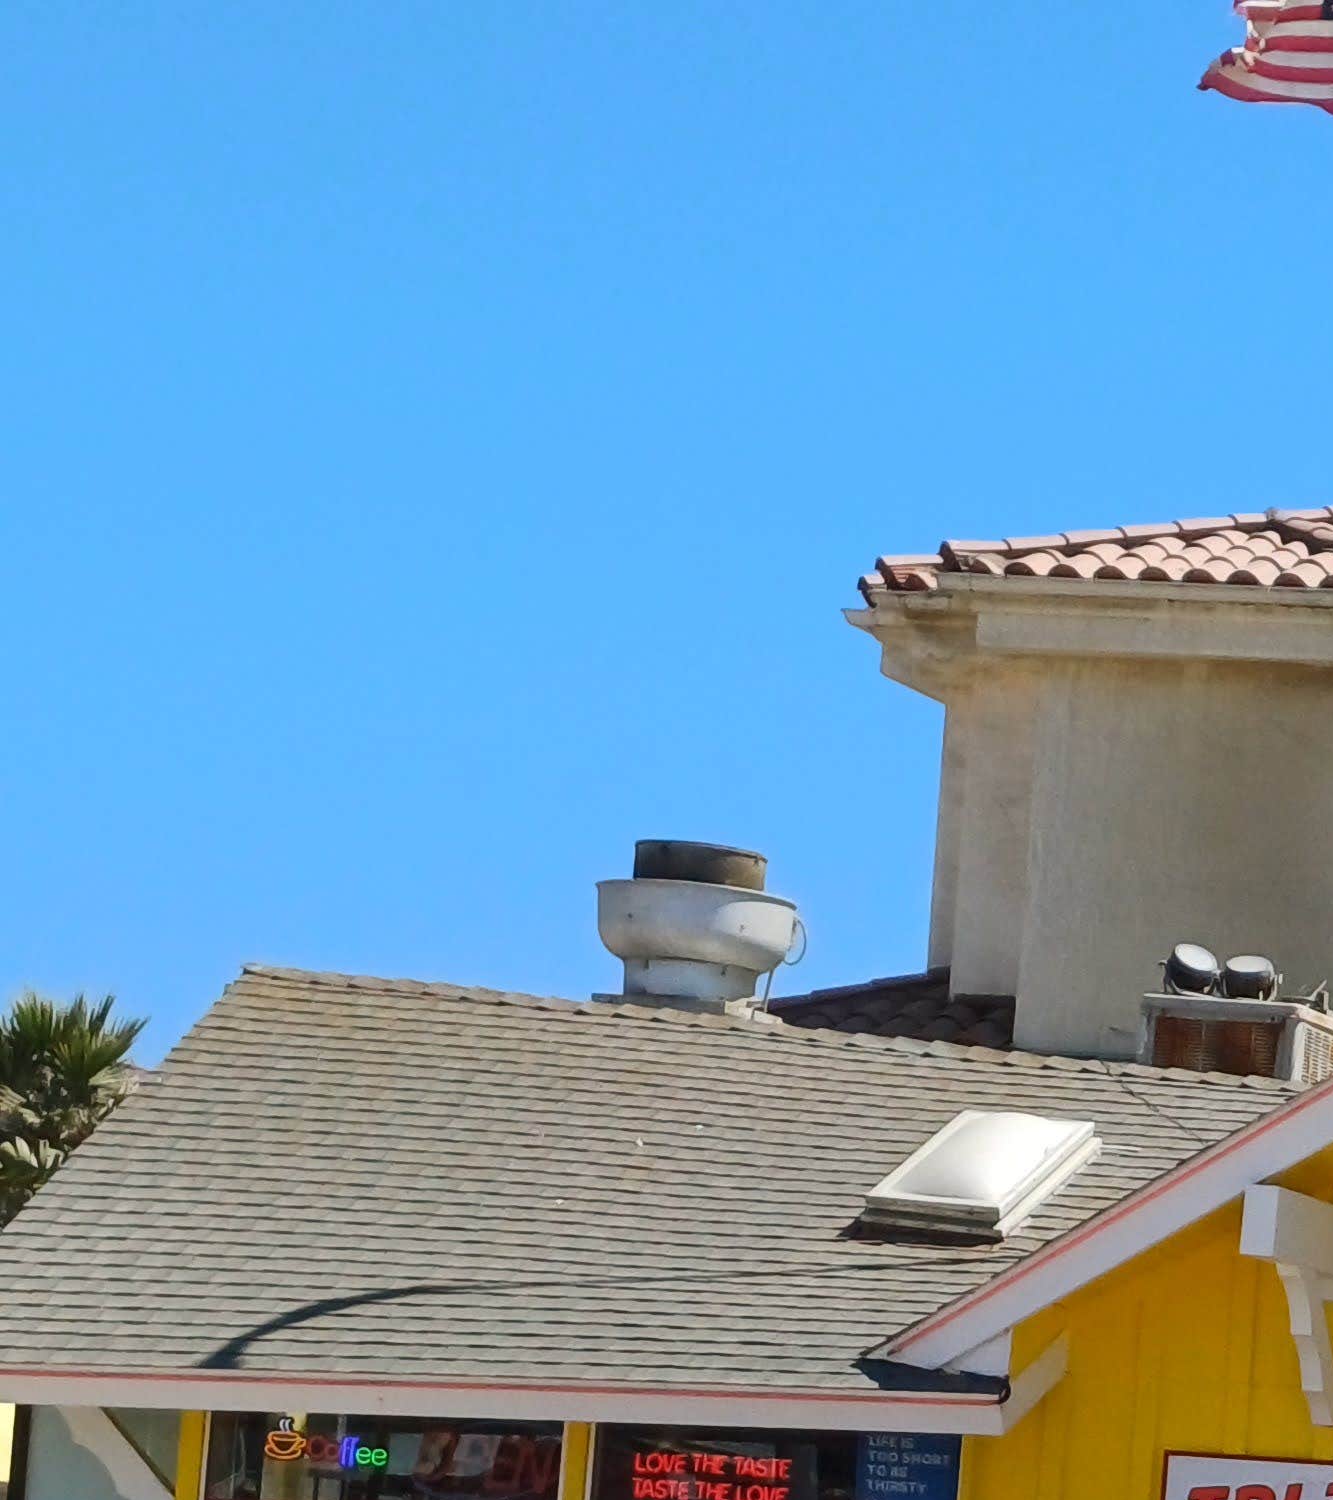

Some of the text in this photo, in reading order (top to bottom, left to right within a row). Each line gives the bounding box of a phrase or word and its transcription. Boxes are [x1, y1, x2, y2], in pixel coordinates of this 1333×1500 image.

[633, 1452, 793, 1480] LOVE THE TASTE
